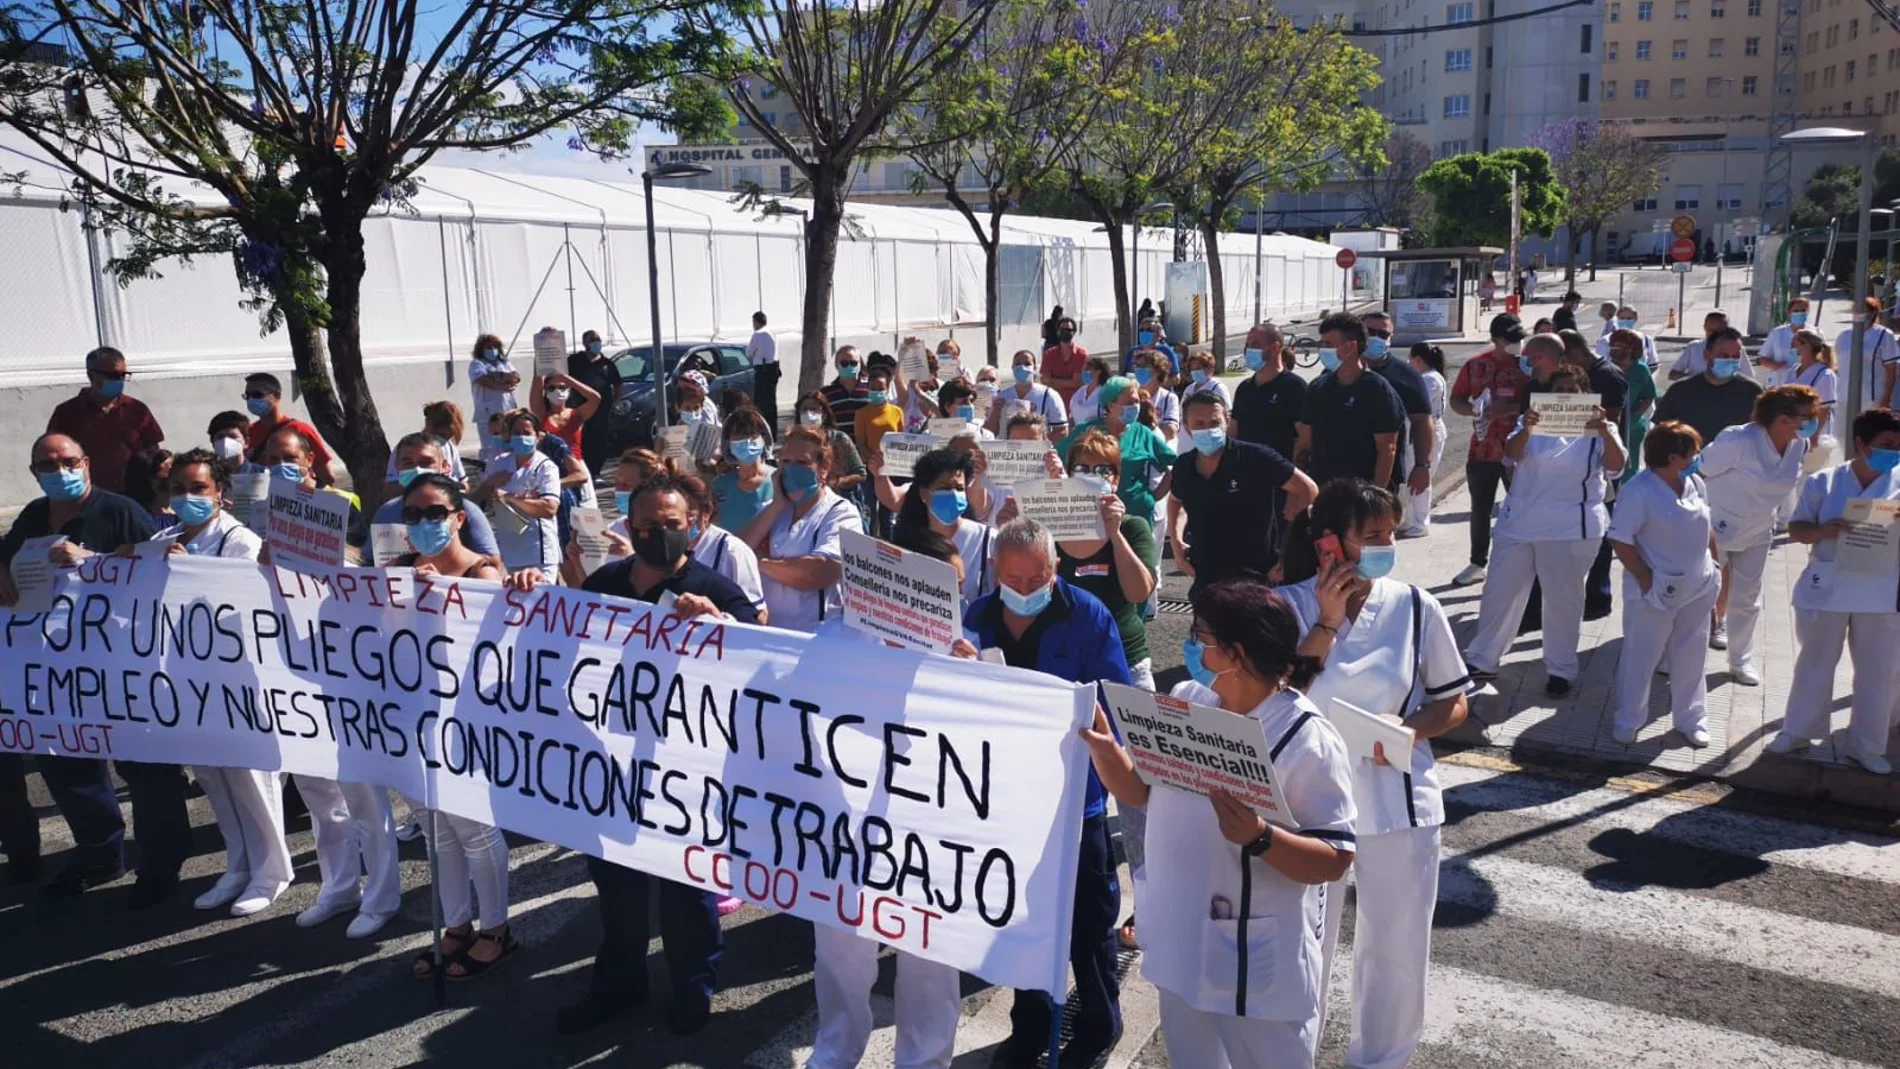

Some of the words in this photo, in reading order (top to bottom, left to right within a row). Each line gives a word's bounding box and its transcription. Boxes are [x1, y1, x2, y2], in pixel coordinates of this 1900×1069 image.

[669, 149, 744, 162] HOSPITAL
[987, 450, 1014, 461] LIMPIEZA
[269, 493, 303, 518] LIMPIEZA
[303, 504, 343, 532] SANITARIA
[844, 567, 891, 598] Conselleria
[892, 588, 908, 604] nos
[910, 595, 953, 621] precariza
[857, 554, 892, 581] balcones
[894, 572, 910, 588] nos
[911, 578, 951, 604] aplauden
[272, 565, 468, 620] LIMPIEZA
[503, 586, 726, 662] SANITARIA
[6, 593, 114, 653] POR
[131, 597, 244, 664] UNOS
[252, 608, 460, 700] PLIEGOS
[472, 640, 561, 715] QUE
[567, 656, 992, 821] GARANTICEN
[1117, 706, 1183, 739] Limpieza
[1186, 724, 1258, 759] Sanitaria
[1127, 730, 1152, 750] es
[1155, 735, 1271, 785] Esencial!!!
[24, 663, 181, 729] EMPLEO
[187, 677, 210, 727] Y
[221, 683, 409, 758] NUESTRAS
[416, 709, 692, 838] CONDICIONES
[700, 775, 759, 859] DE
[763, 792, 1017, 929] TRABAJO
[683, 844, 944, 950] CCOO-UGT
